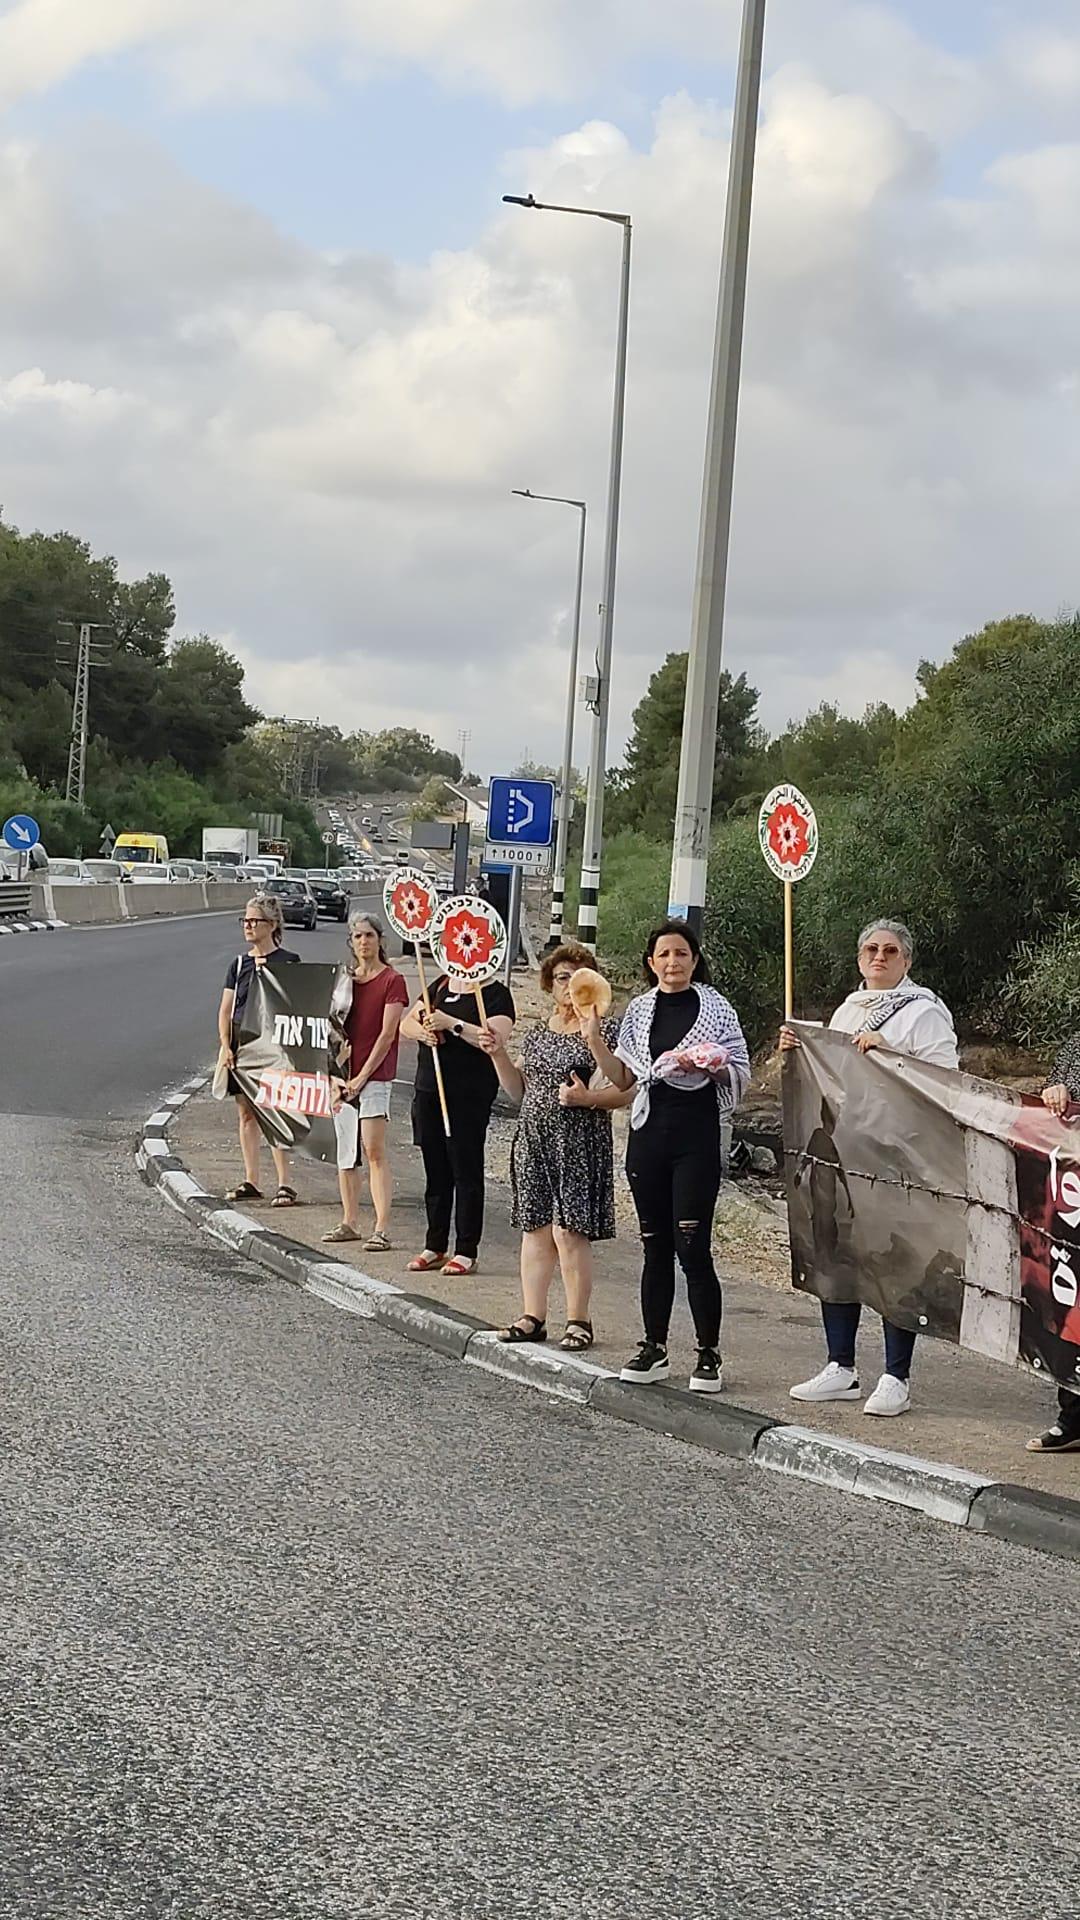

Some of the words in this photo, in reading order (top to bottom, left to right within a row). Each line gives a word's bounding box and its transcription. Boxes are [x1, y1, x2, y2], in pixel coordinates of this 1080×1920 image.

[502, 850, 533, 861] 1000
[436, 898, 473, 925] לכיבוש
[477, 902, 490, 914] די
[488, 954, 500, 969] כן
[447, 964, 488, 979] לשלום
[271, 1014, 304, 1047] את
[307, 1017, 330, 1049] צור
